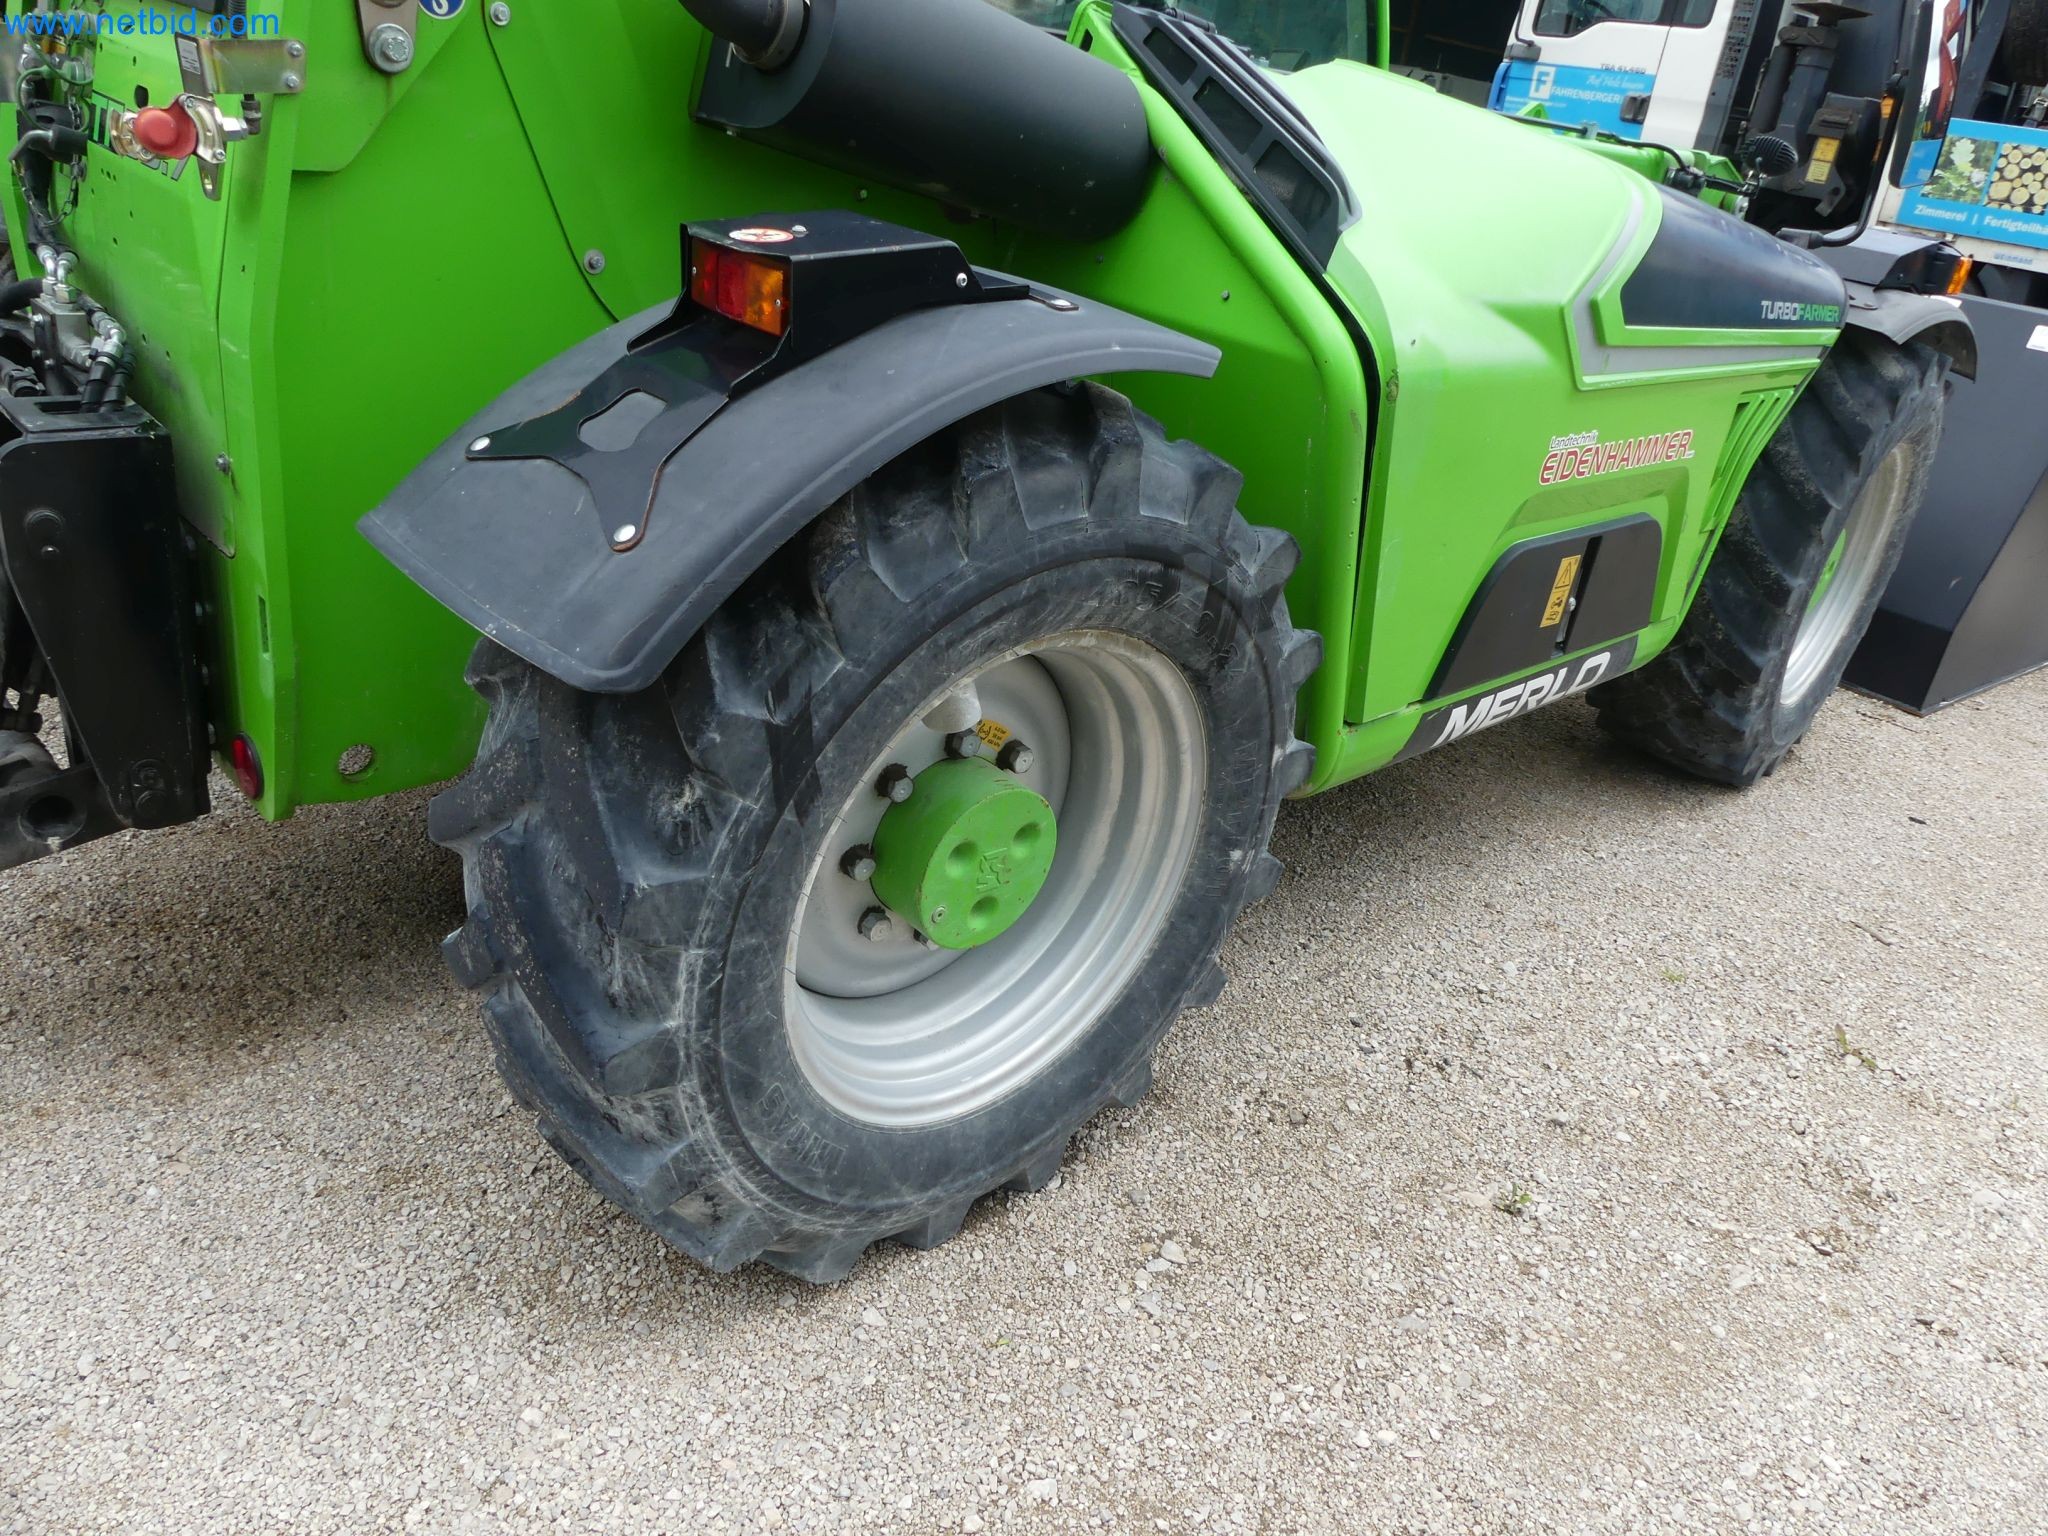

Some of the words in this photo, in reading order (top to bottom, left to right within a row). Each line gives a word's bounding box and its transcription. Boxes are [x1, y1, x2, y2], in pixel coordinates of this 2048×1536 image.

[1551, 86, 1621, 104] FAHRENBERGER
[1914, 204, 1967, 222] Zimmerei
[1760, 300, 1840, 322] TURBOFARMER
[1549, 430, 1598, 450] Landtechnik
[1539, 430, 1694, 485] EIDENHAMMER
[1430, 651, 1611, 748] MERLO
